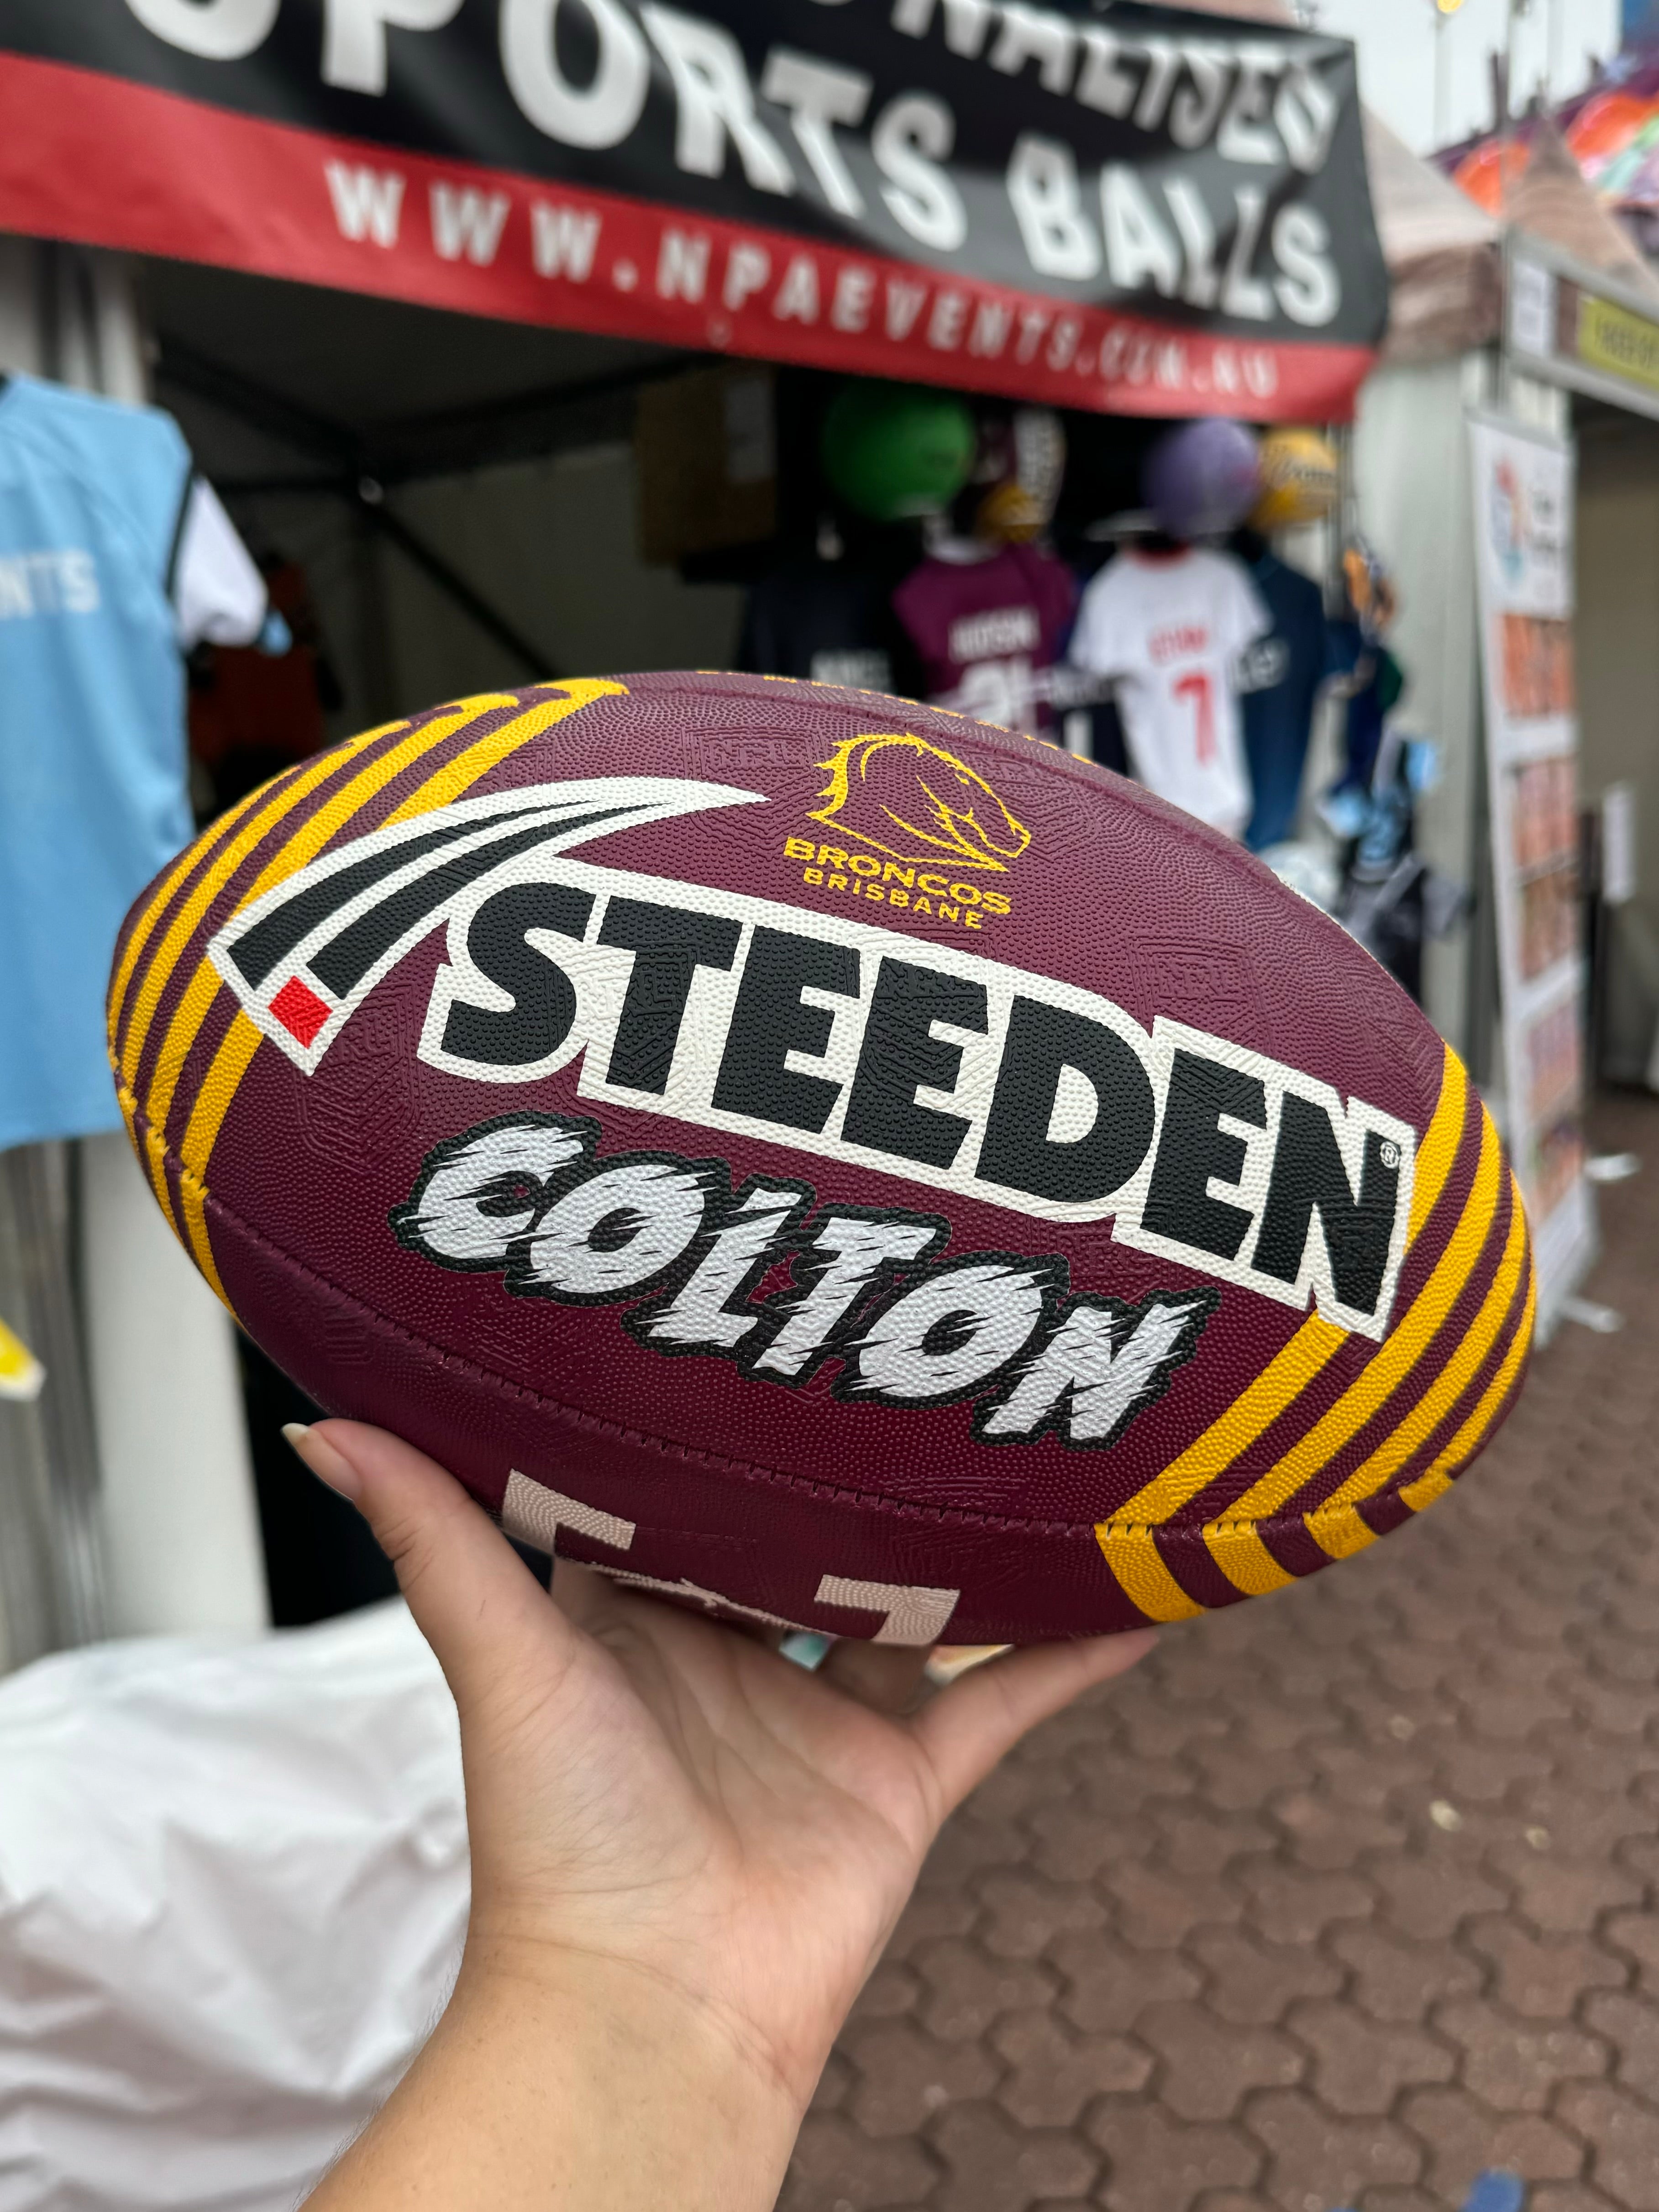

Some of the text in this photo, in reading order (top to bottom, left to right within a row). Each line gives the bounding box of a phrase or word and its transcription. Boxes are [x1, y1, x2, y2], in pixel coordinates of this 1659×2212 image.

[1006, 129, 1341, 328] BALLS
[783, 836, 1012, 915] BRONCOS
[803, 867, 983, 930] BRISBANE
[439, 881, 1402, 1317] STEEDEN
[396, 1122, 1212, 1441] COLTON
